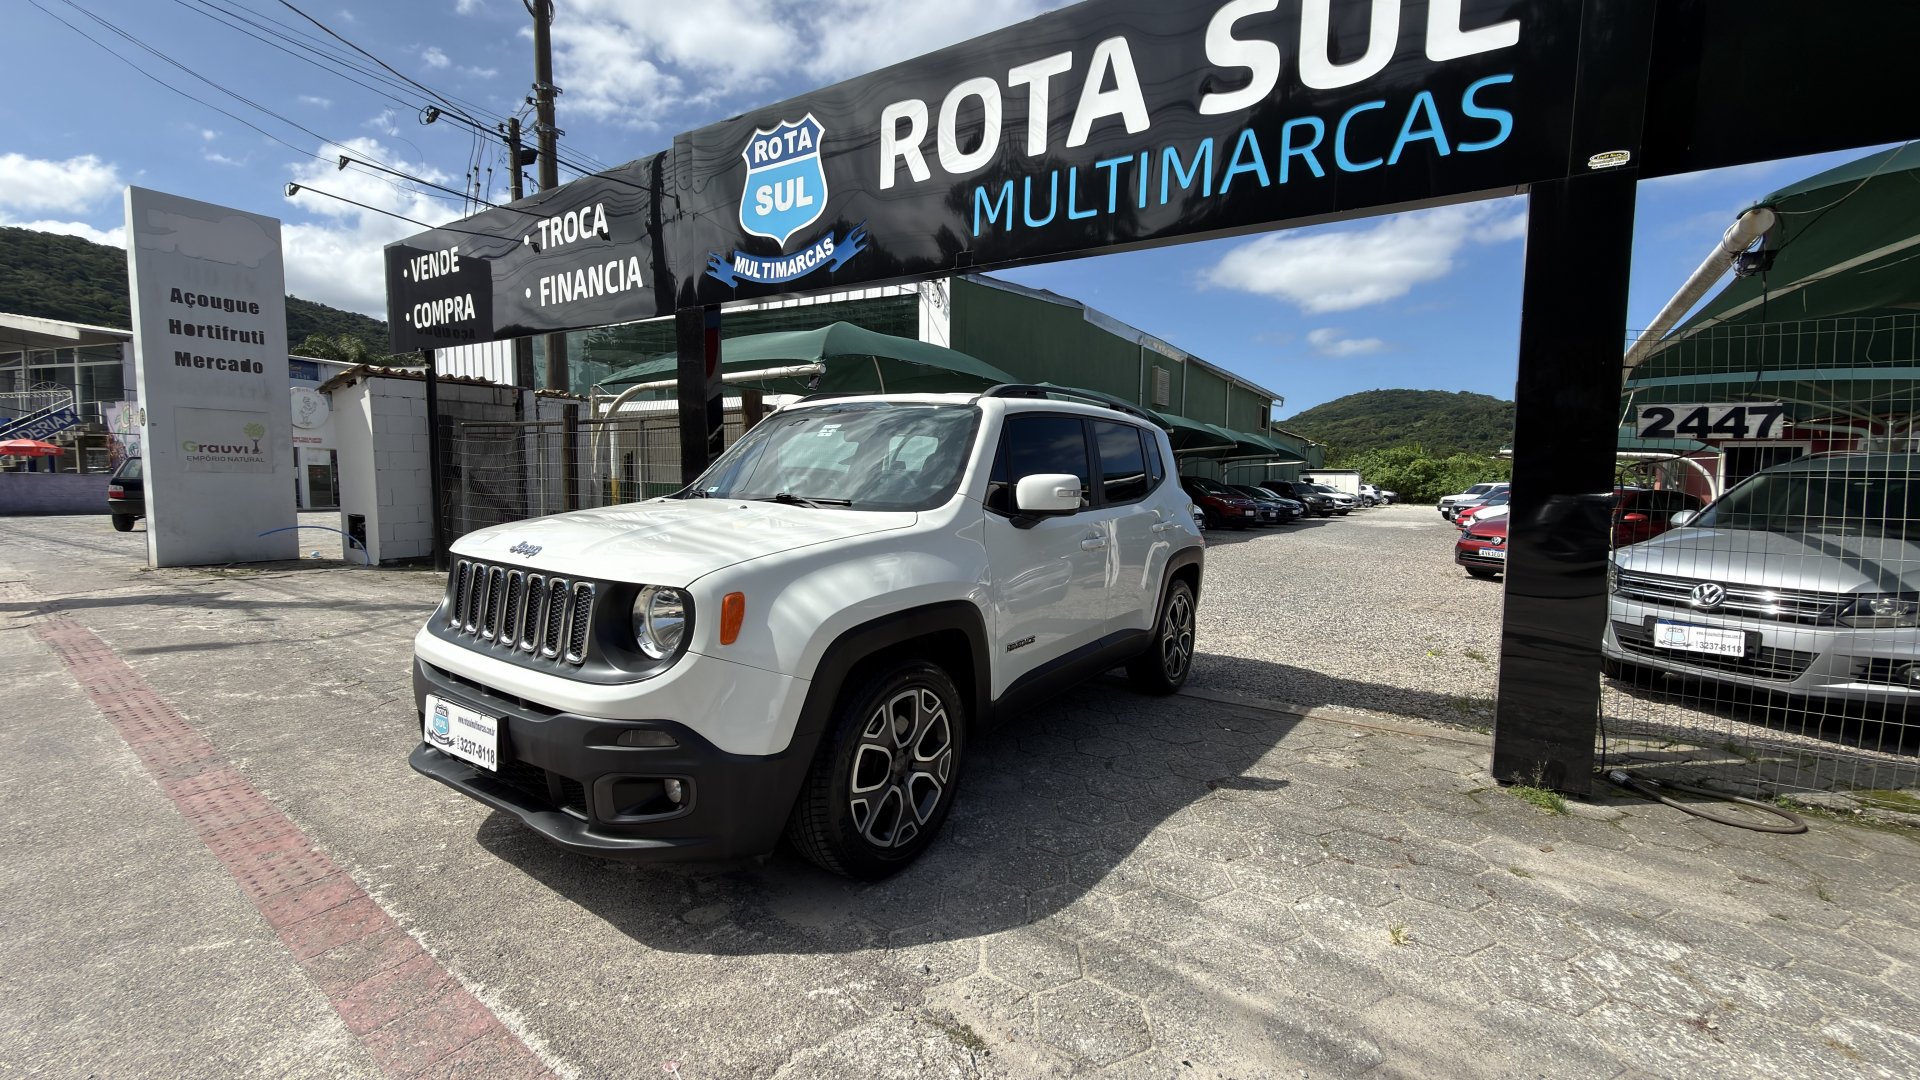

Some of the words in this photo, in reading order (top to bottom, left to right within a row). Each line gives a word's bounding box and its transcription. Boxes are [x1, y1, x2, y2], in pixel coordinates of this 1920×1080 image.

[879, 35, 1151, 190] ROTA
[754, 126, 813, 164] ROTA
[972, 73, 1515, 237] MULTIMARCAS
[755, 176, 813, 216] SUL
[537, 202, 609, 250] TROCA
[410, 245, 460, 283] VENDE
[733, 237, 835, 279] MULTIMARCAS
[539, 255, 644, 307] FINANCIA
[169, 287, 260, 315] Açougue
[413, 293, 476, 329] COMPRA
[168, 318, 265, 346] Hortifruti
[174, 350, 264, 375] Mercado
[1638, 406, 1784, 439] 2447
[182, 440, 249, 454] Grauvi
[1698, 640, 1742, 654] 3237-8118
[459, 736, 495, 764] 3237-8118
